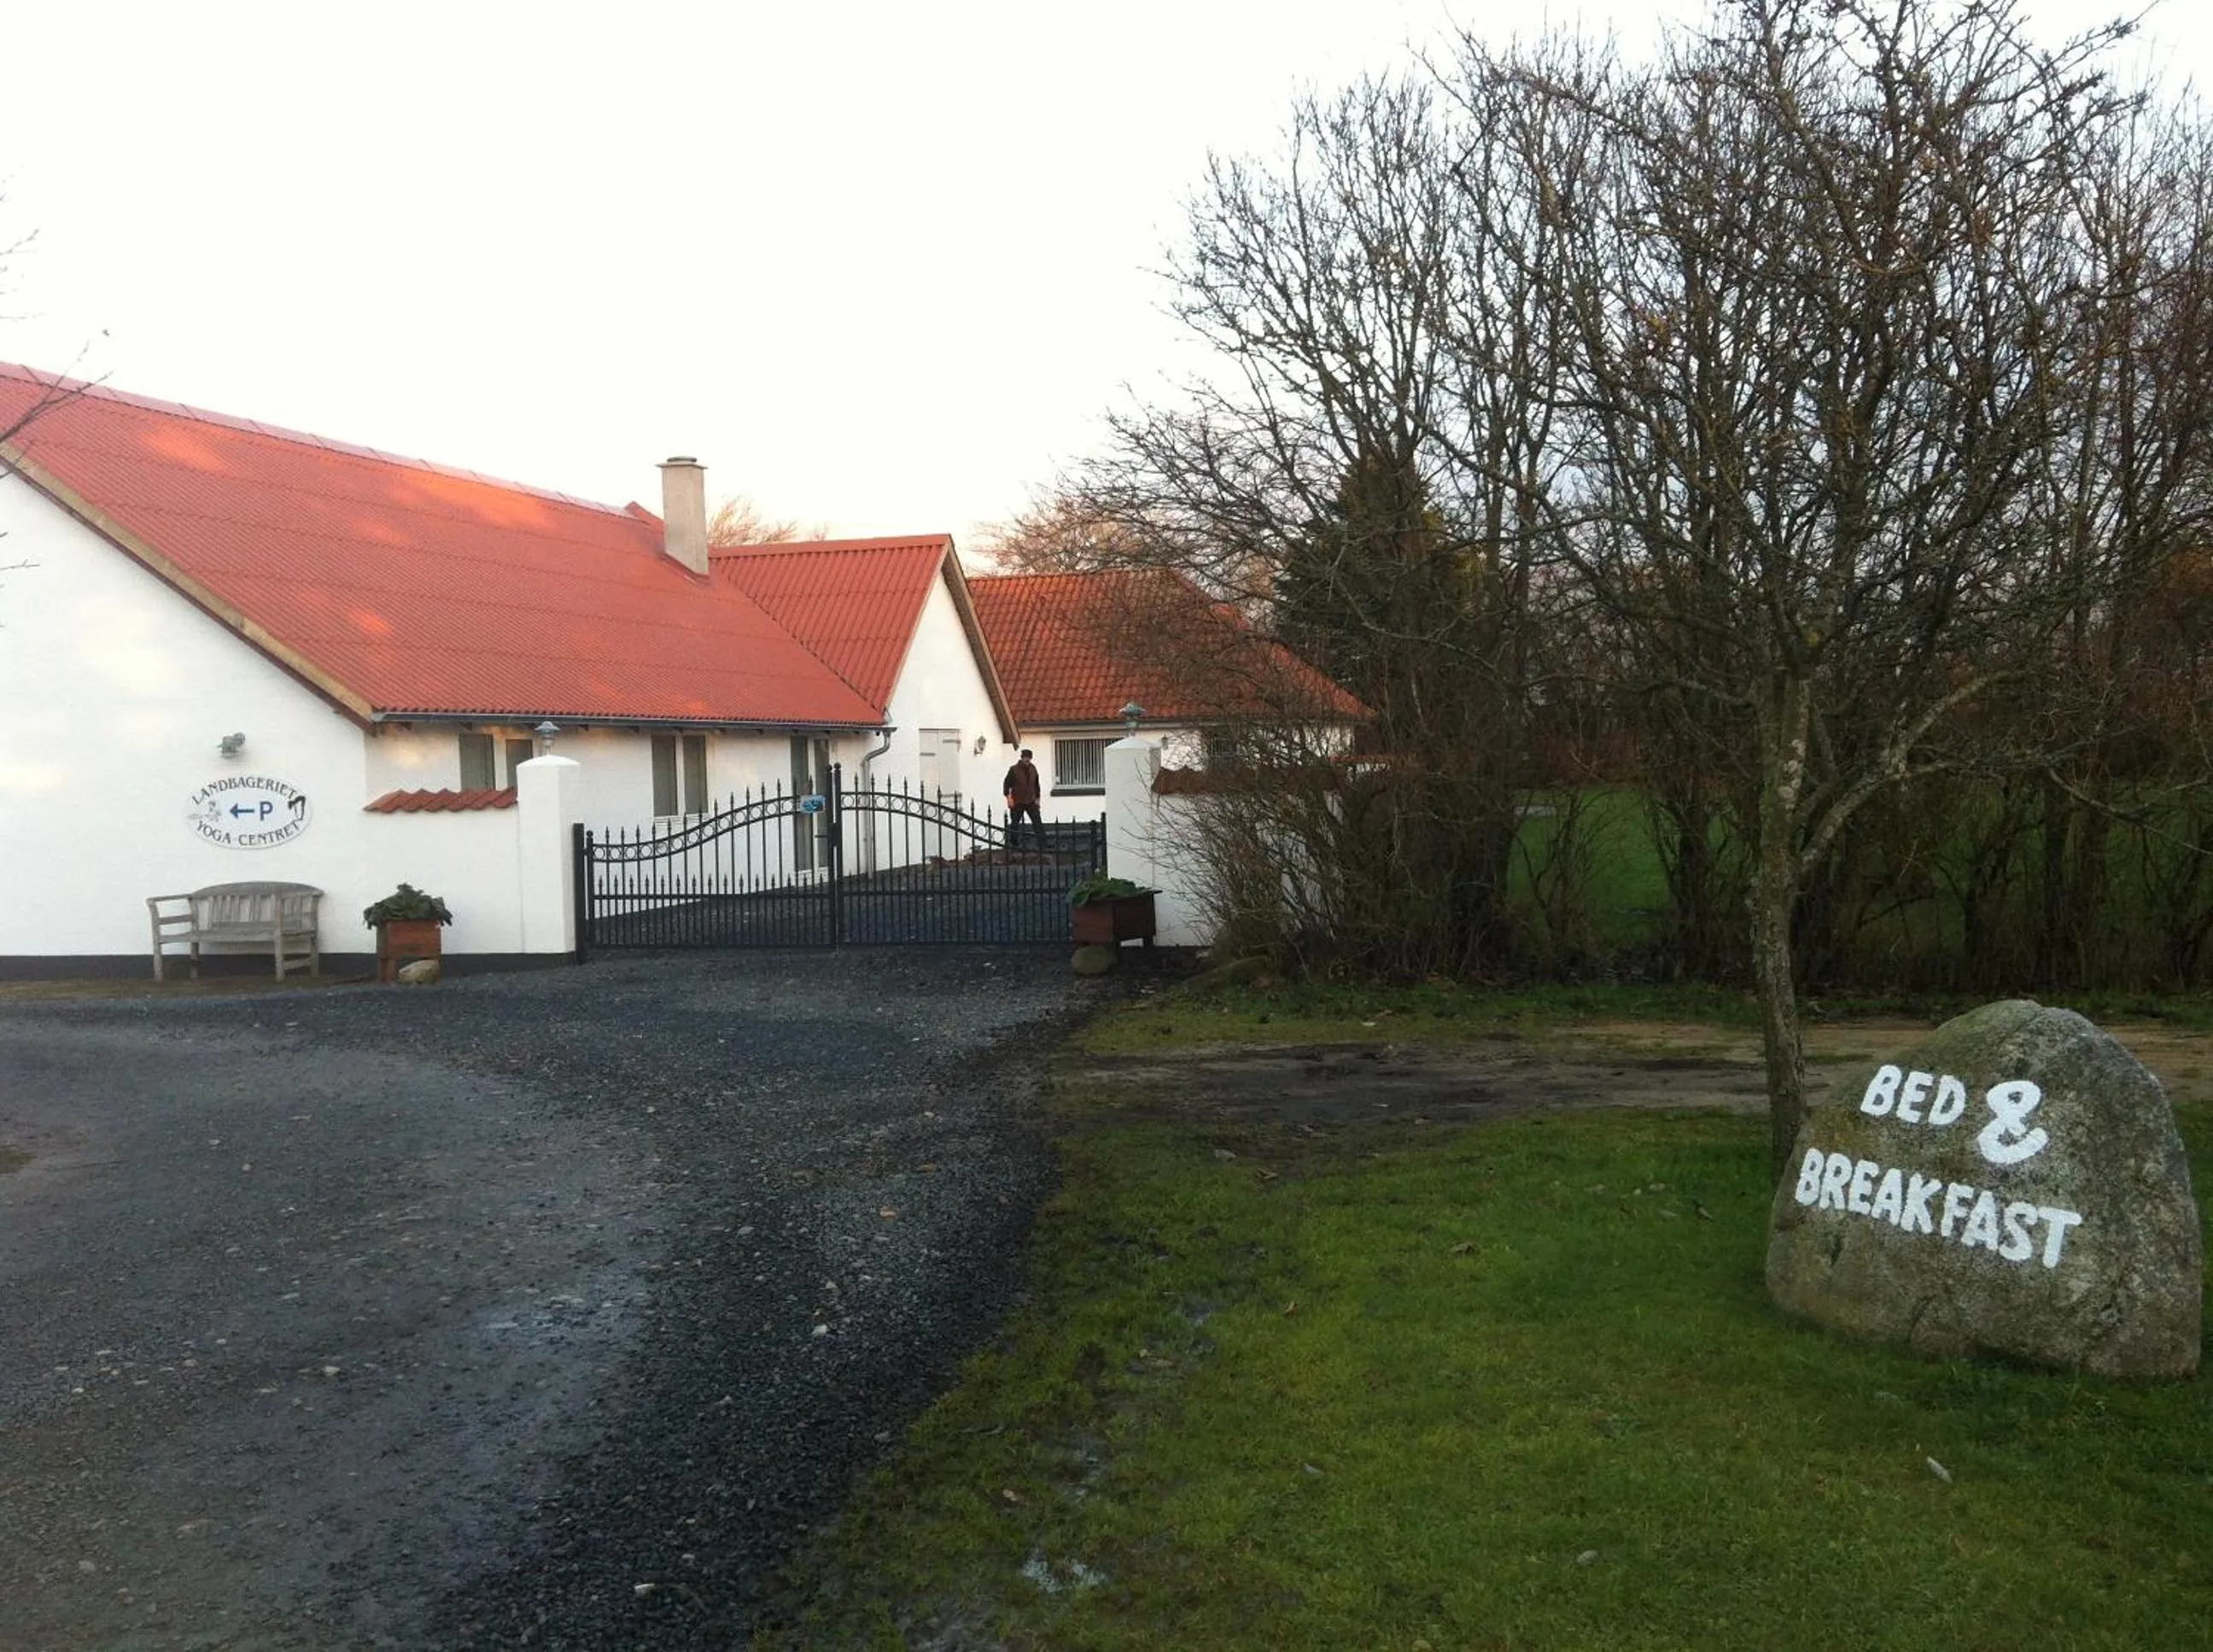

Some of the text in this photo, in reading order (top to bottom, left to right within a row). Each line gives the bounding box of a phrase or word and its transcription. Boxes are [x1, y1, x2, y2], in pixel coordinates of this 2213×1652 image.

[192, 776, 296, 805] LANDBAGERIET
[260, 801, 273, 820] P
[197, 820, 300, 846] YOGA CENTRET
[1860, 1065, 2049, 1164] BED &
[1796, 1148, 2082, 1269] BREAKFAST
